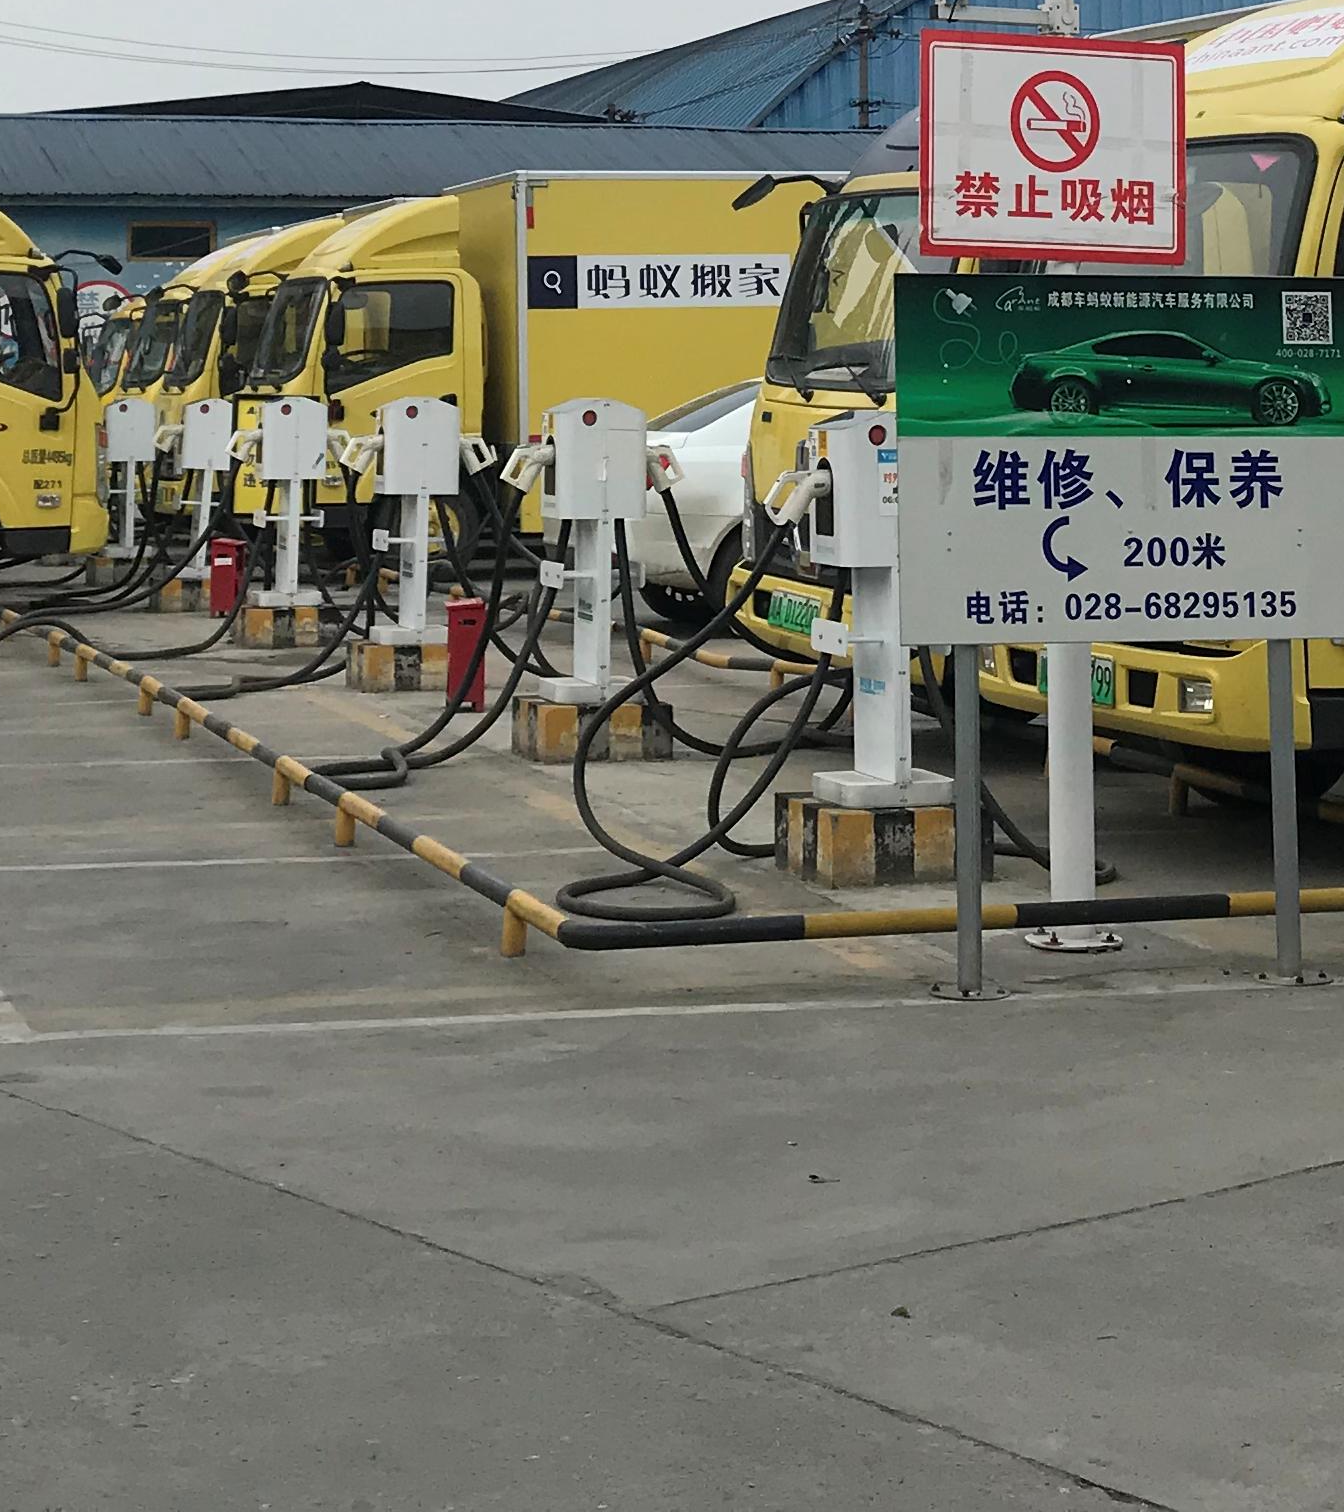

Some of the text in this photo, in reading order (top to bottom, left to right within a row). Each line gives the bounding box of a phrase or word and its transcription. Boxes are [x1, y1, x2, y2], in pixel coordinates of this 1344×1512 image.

[953, 170, 1155, 226] 禁止吸烟
[587, 262, 782, 300] 蚂蚁搬家
[1047, 290, 1255, 309] 成都车蚂蚁新能源汽车服务有限公司
[1275, 348, 1342, 358] 400-028-7171
[1122, 532, 1227, 570] 200米
[1064, 590, 1298, 621] 028-68295135
